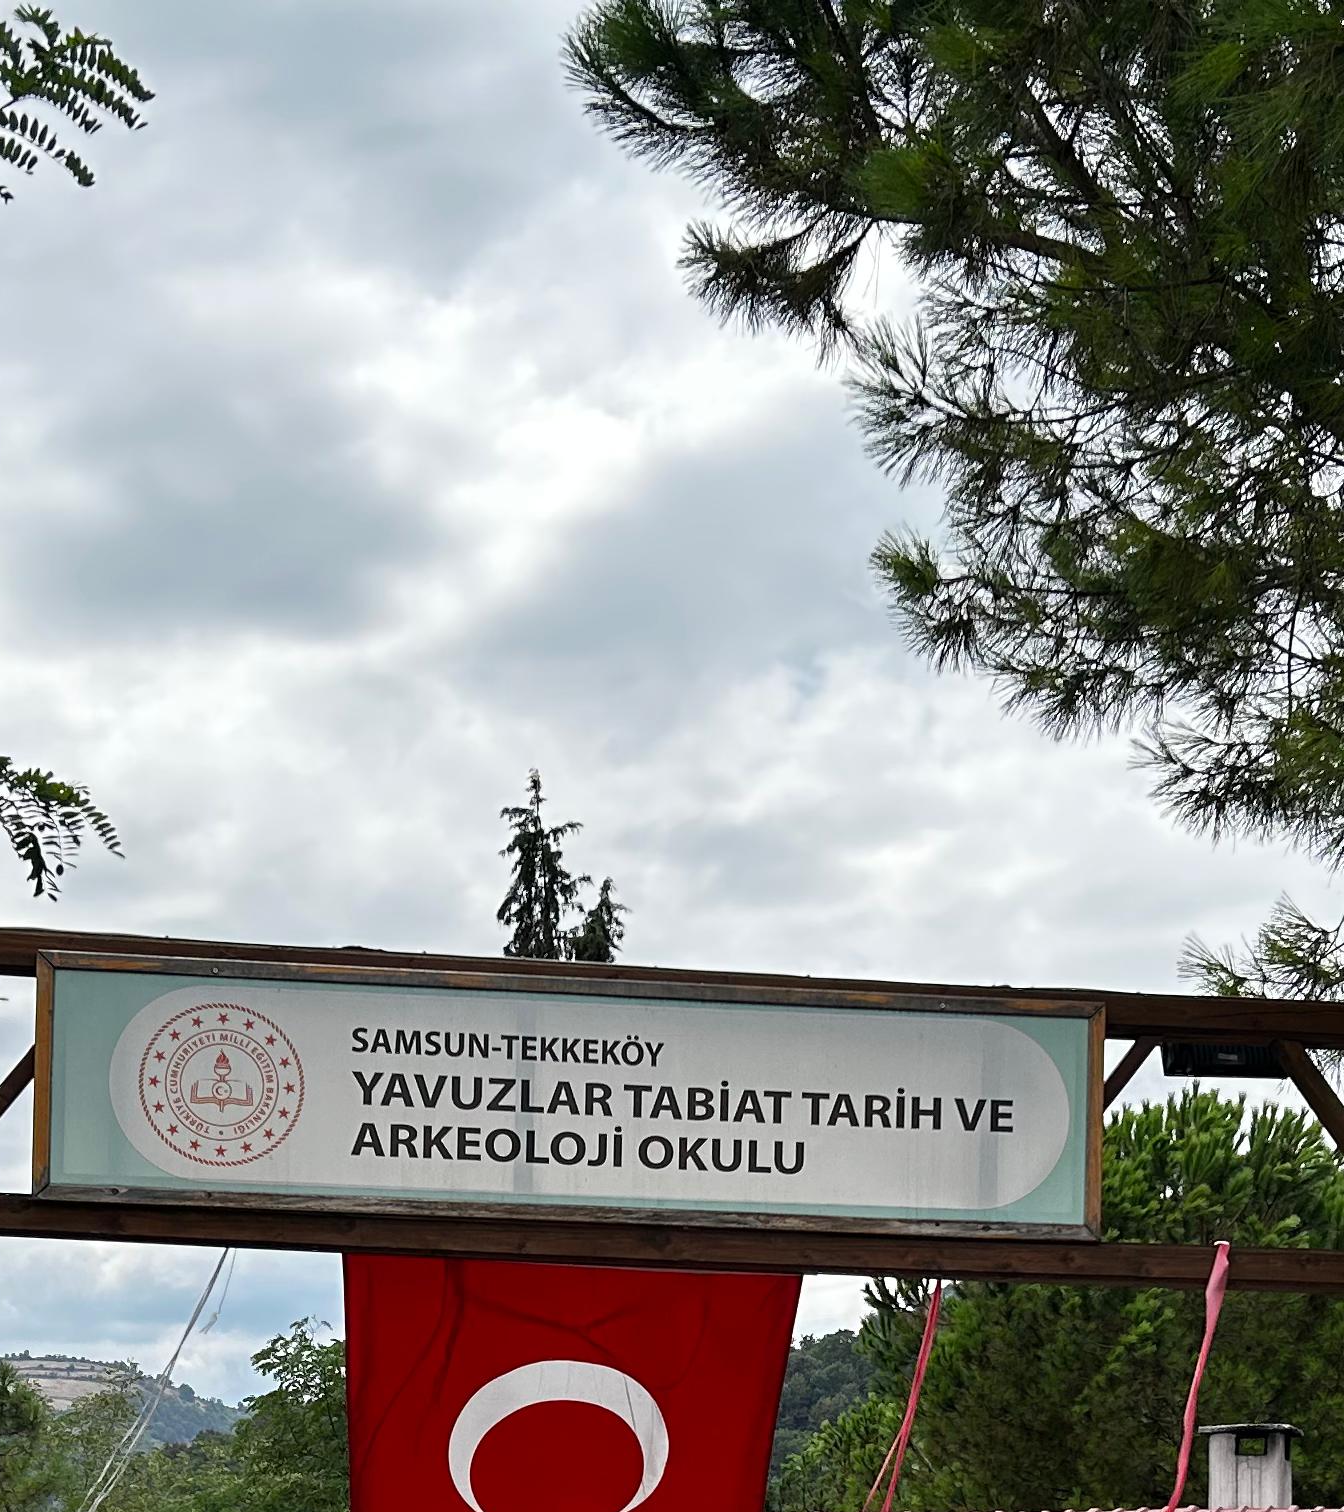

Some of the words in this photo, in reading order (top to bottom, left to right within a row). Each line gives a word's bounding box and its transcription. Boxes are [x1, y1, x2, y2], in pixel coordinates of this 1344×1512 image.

[351, 1027, 664, 1067] SAMSUN-TEKKEKÖY
[169, 1033, 216, 1095] CUMHURİYETİ
[233, 1087, 275, 1136] BAKANLIĞI
[351, 1070, 613, 1118] YAVUZLAR
[623, 1080, 792, 1125] TABİAT
[801, 1087, 942, 1131] TARİH
[954, 1098, 1014, 1133] VE
[350, 1122, 623, 1168] ARKEOLOJİ
[637, 1135, 805, 1175] OKULU
